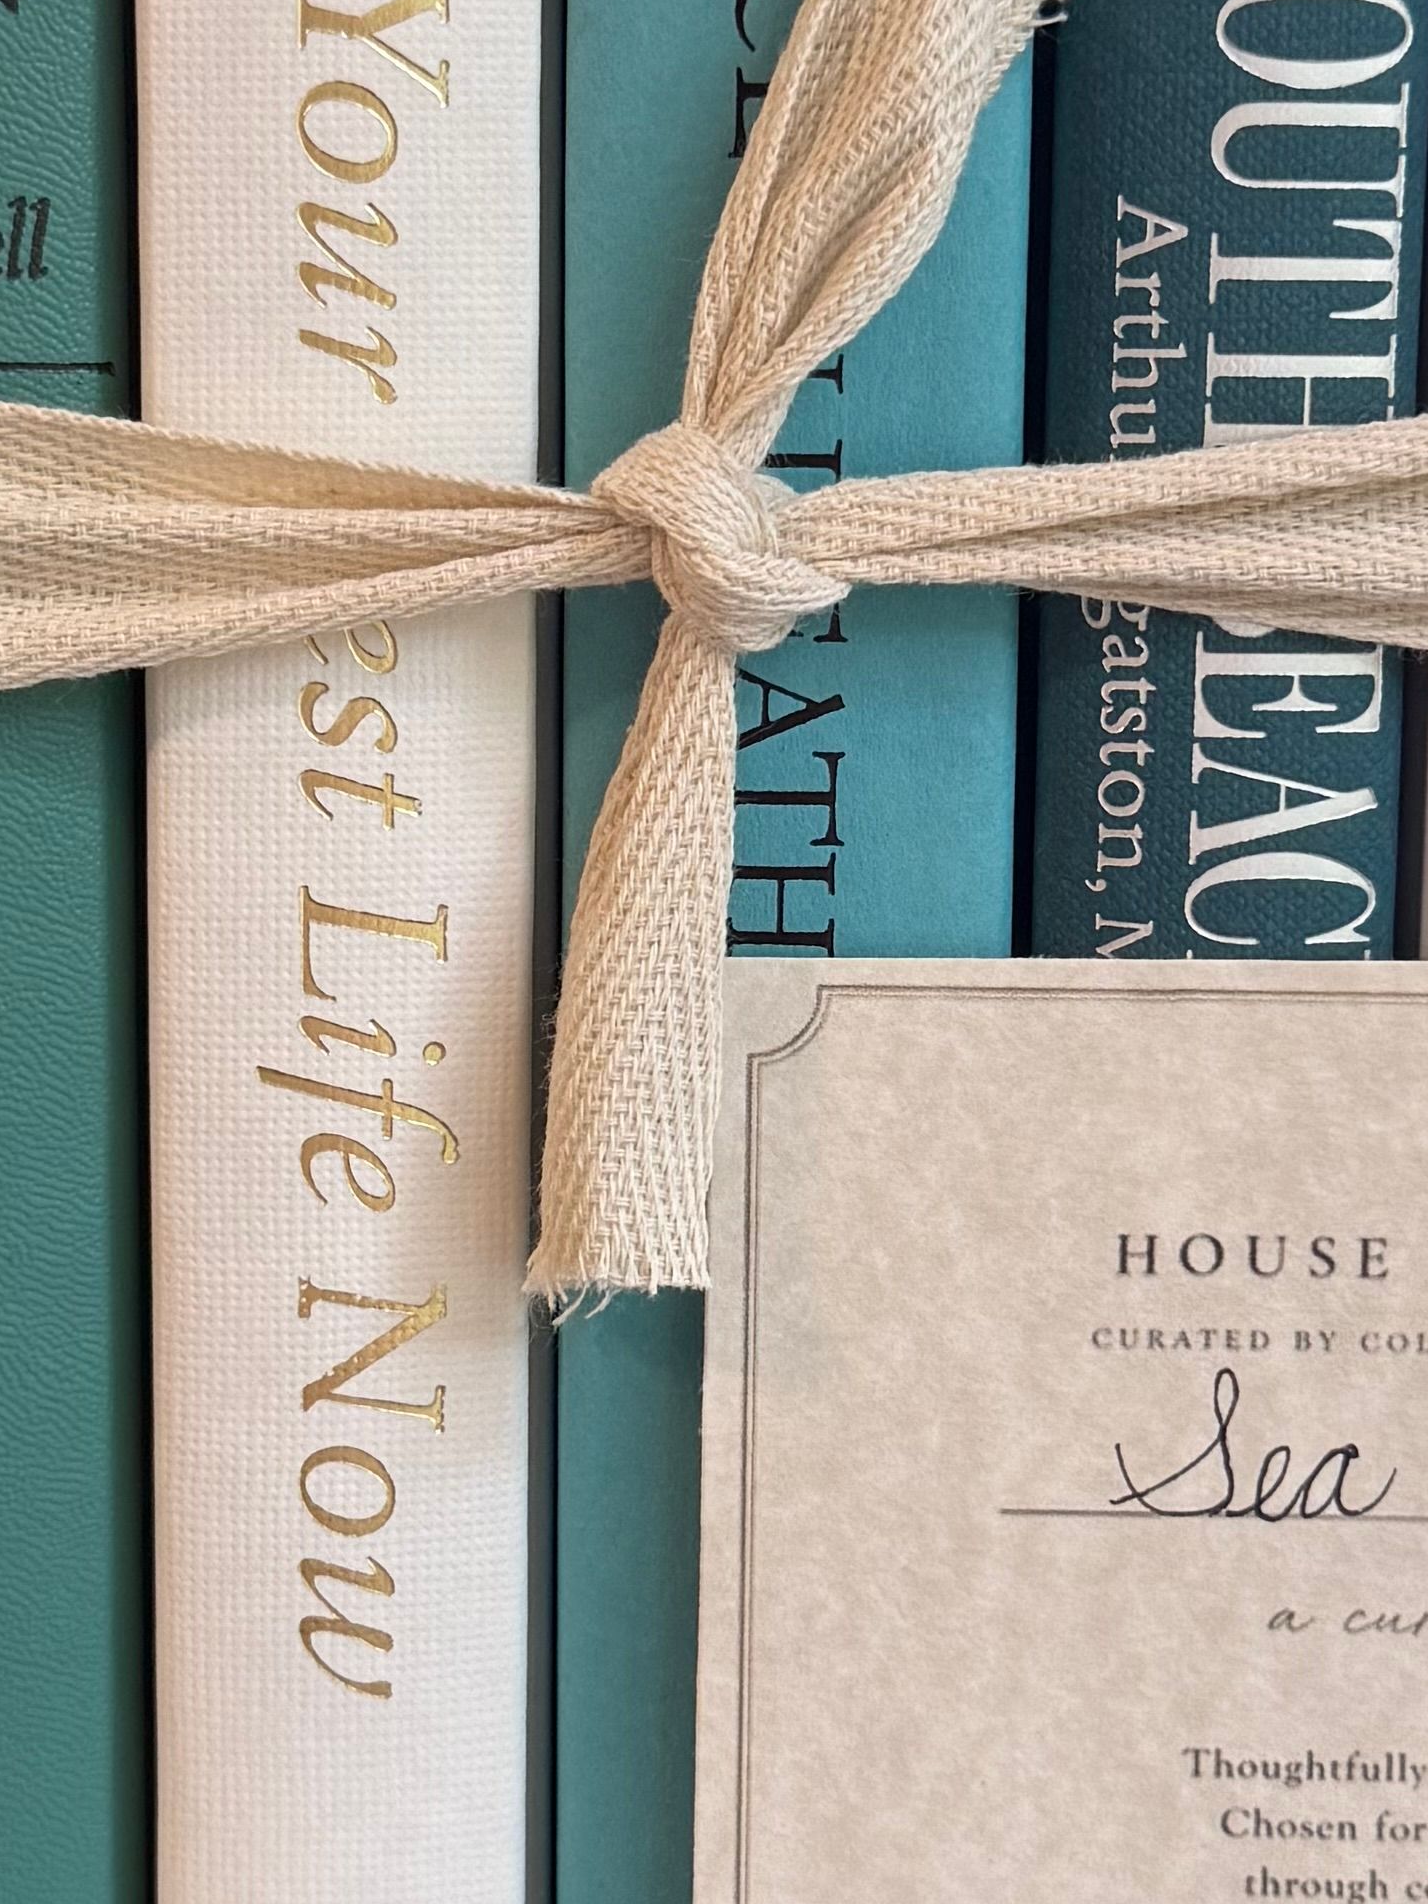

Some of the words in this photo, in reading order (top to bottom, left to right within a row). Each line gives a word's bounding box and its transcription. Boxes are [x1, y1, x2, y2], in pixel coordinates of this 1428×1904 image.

[1109, 194, 1190, 464] Arthu
[299, 617, 425, 833] est
[1184, 617, 1386, 961] EAC
[256, 884, 459, 1216] Life
[1115, 1232, 1390, 1282] HOUSE
[1090, 1327, 1271, 1353] CURATED
[1294, 1329, 1338, 1354] BY
[298, 1274, 449, 1702] Now
[1110, 1367, 1398, 1523] Sea
[1266, 1611, 1314, 1634] a
[1180, 1746, 1428, 1791] Thoughtfully
[1219, 1807, 1358, 1842] Chosen
[1375, 1809, 1428, 1844] for
